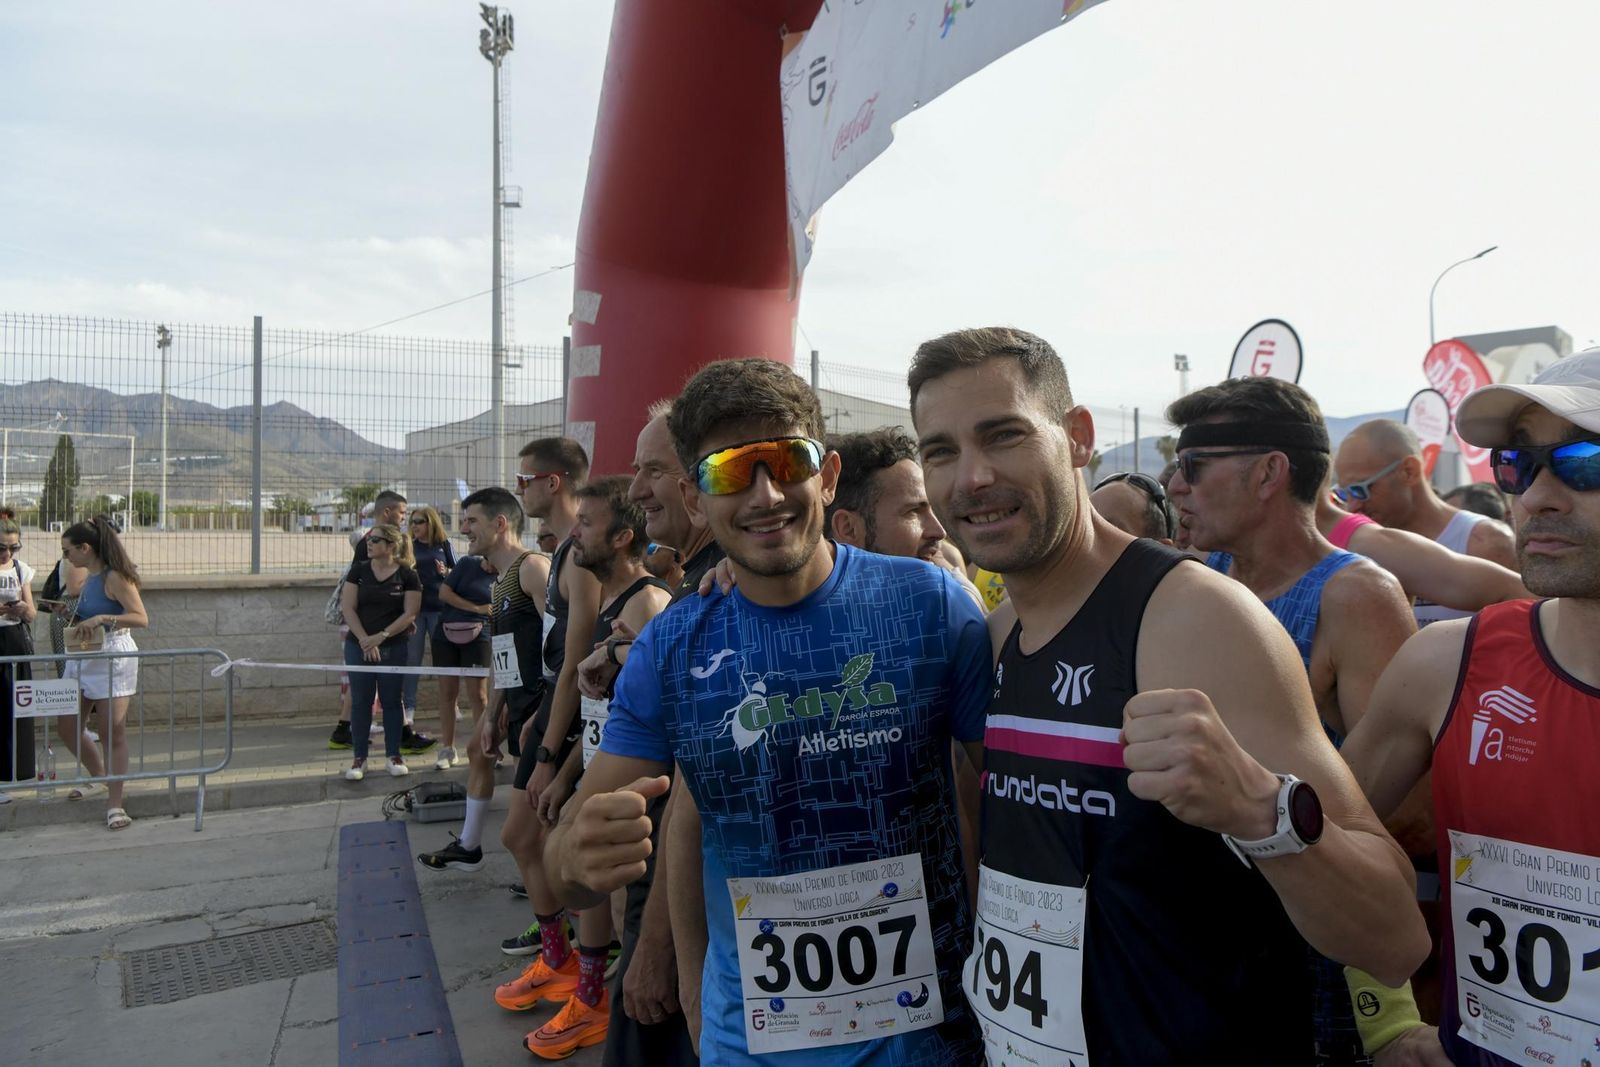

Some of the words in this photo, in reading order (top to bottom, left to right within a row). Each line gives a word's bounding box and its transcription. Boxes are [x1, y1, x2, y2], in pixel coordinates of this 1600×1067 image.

[35, 688, 77, 698] Diputación
[45, 695, 77, 704] Granada
[869, 707, 900, 718] ESPADA
[798, 727, 902, 756] Atletismo
[988, 773, 1115, 817] rundata
[1478, 841, 1508, 864] XXXVI
[881, 862, 905, 879] 2023
[1037, 890, 1063, 912] 2023
[1502, 899, 1519, 910] GRAN
[1520, 903, 1545, 917] PREMIO
[1546, 910, 1555, 918] DE
[1557, 912, 1581, 924] FONDO
[750, 914, 917, 994] 3007
[767, 1012, 799, 1021] Diputación
[775, 1019, 800, 1027] Granada
[1490, 1014, 1515, 1033] Granada
